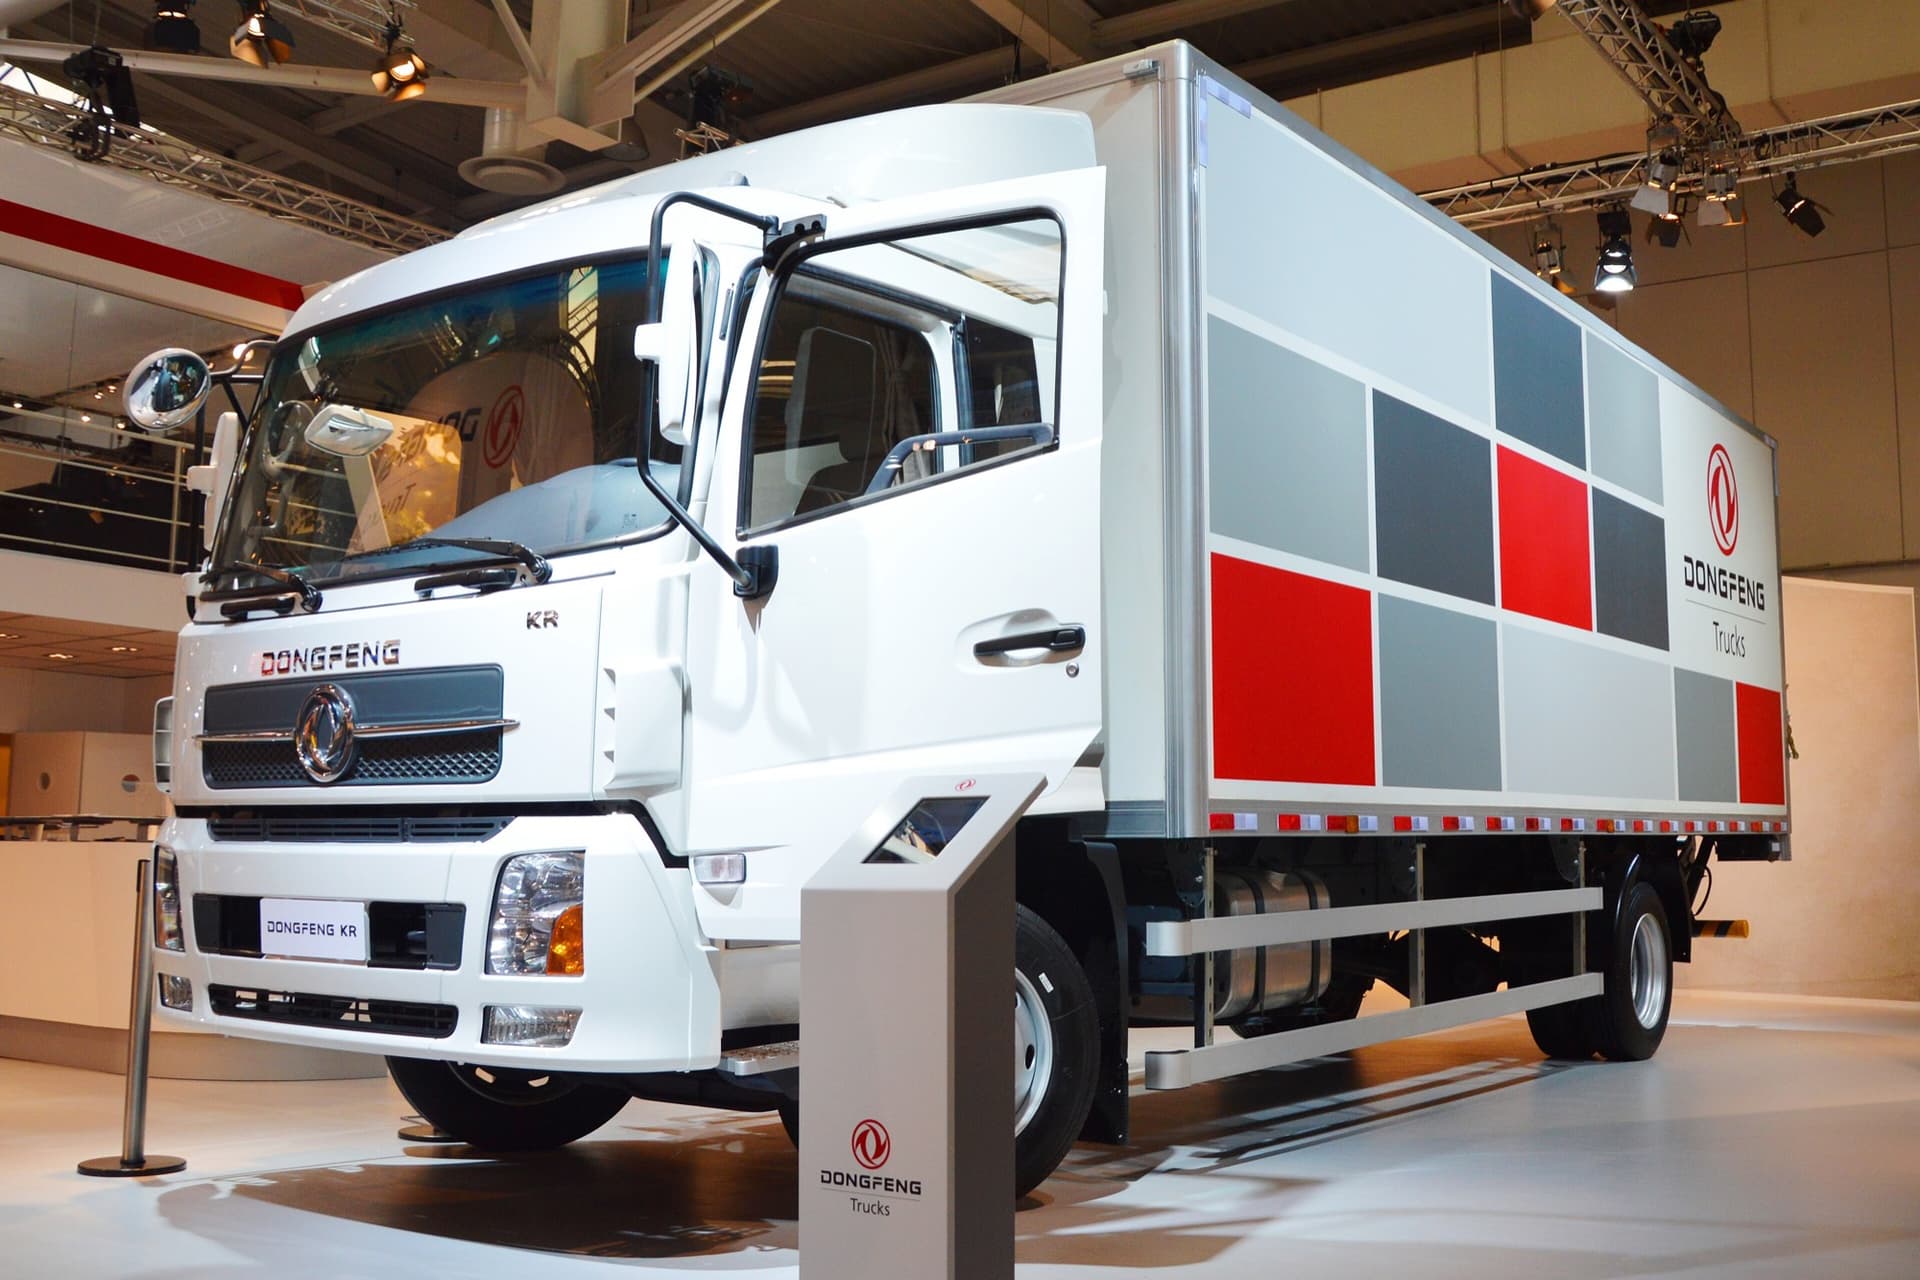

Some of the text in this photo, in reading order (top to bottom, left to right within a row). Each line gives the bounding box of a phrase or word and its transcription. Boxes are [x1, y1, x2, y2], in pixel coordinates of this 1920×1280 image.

[1683, 554, 1766, 611] DONGFENG
[526, 609, 559, 630] KR
[1712, 620, 1746, 658] Trucks
[260, 639, 401, 677] DONGFENG
[267, 920, 358, 938] DONGFENG KR
[820, 1169, 922, 1196] DONGFENG
[849, 1197, 891, 1217] Trucks
